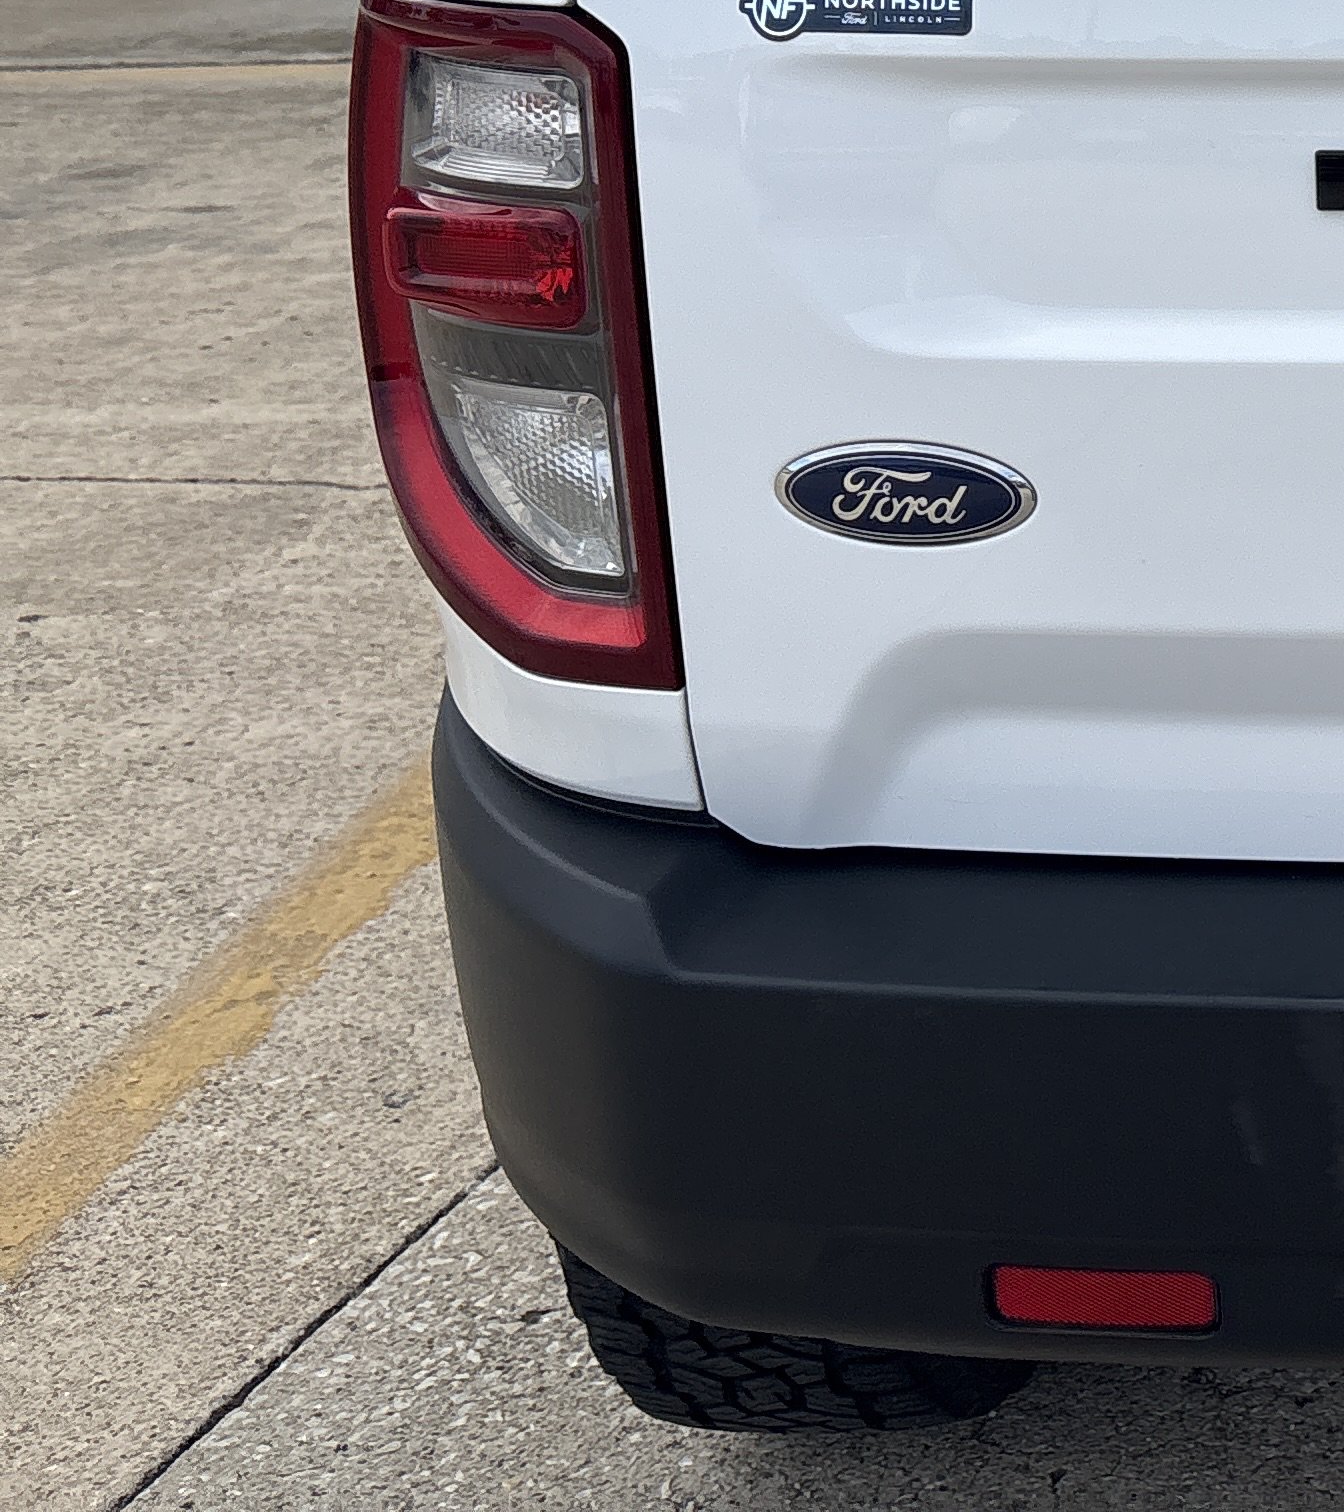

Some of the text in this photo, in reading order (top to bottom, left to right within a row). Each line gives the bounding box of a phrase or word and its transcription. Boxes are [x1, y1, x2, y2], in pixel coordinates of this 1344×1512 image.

[841, 11, 943, 25] Ford LINCOLN
[831, 465, 968, 525] Ford
